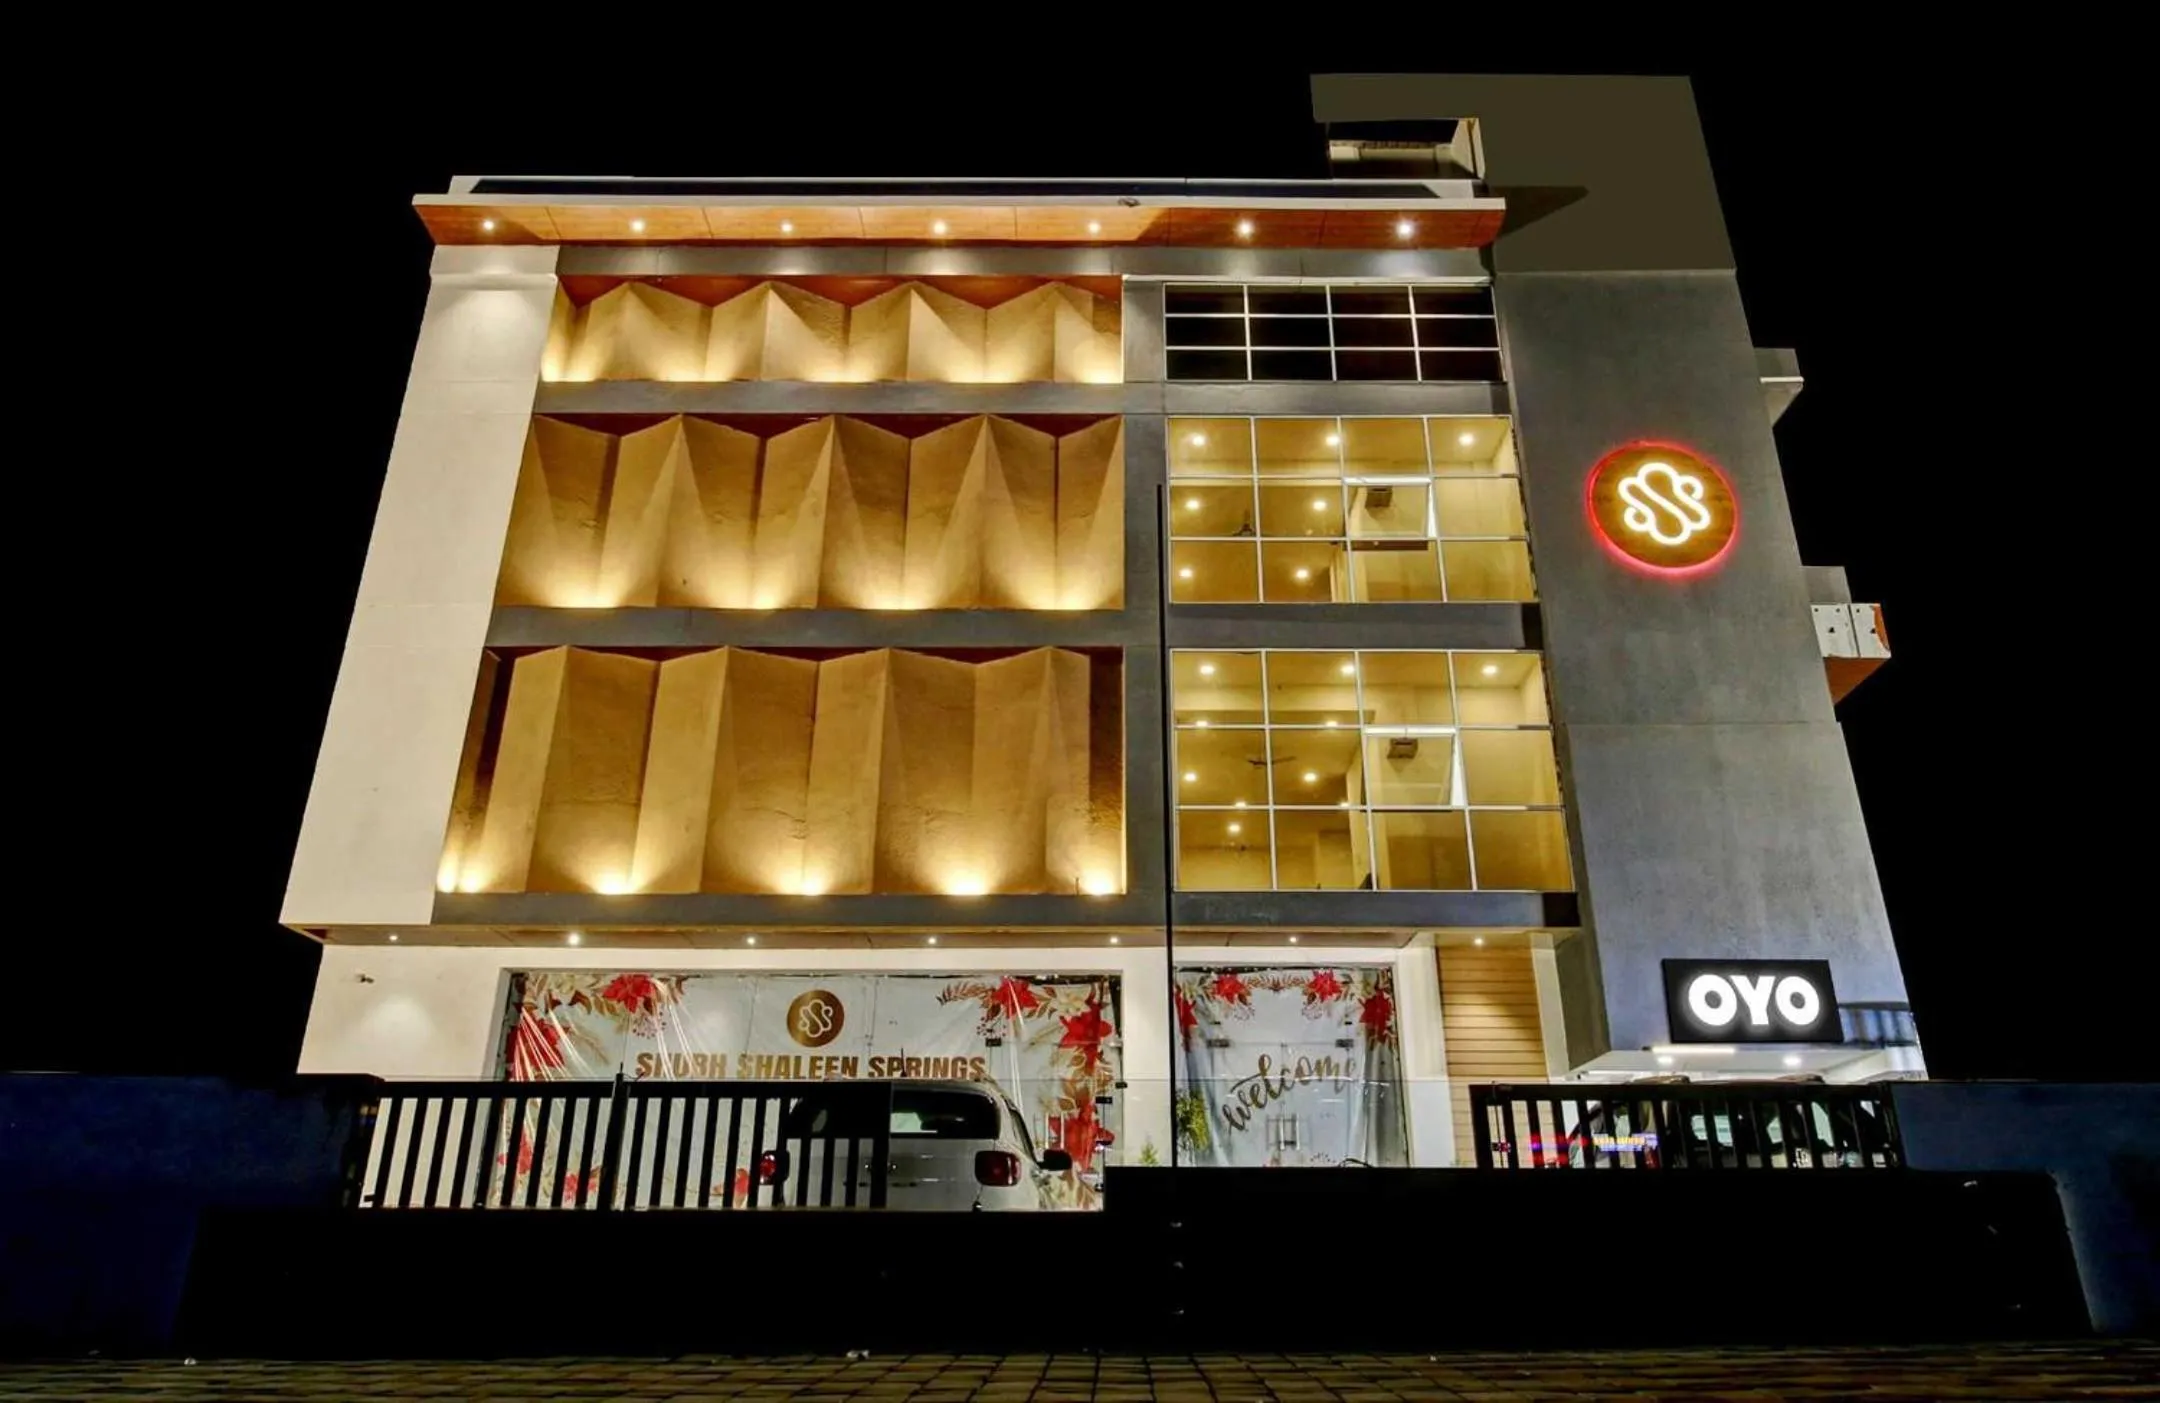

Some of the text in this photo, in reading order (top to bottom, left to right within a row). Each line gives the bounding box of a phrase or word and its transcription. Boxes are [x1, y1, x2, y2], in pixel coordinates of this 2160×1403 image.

[1688, 974, 1820, 1026] OYO
[635, 1052, 985, 1080] SHUBH SHALEEN SPRINGS
[1222, 1054, 1356, 1136] welcome
